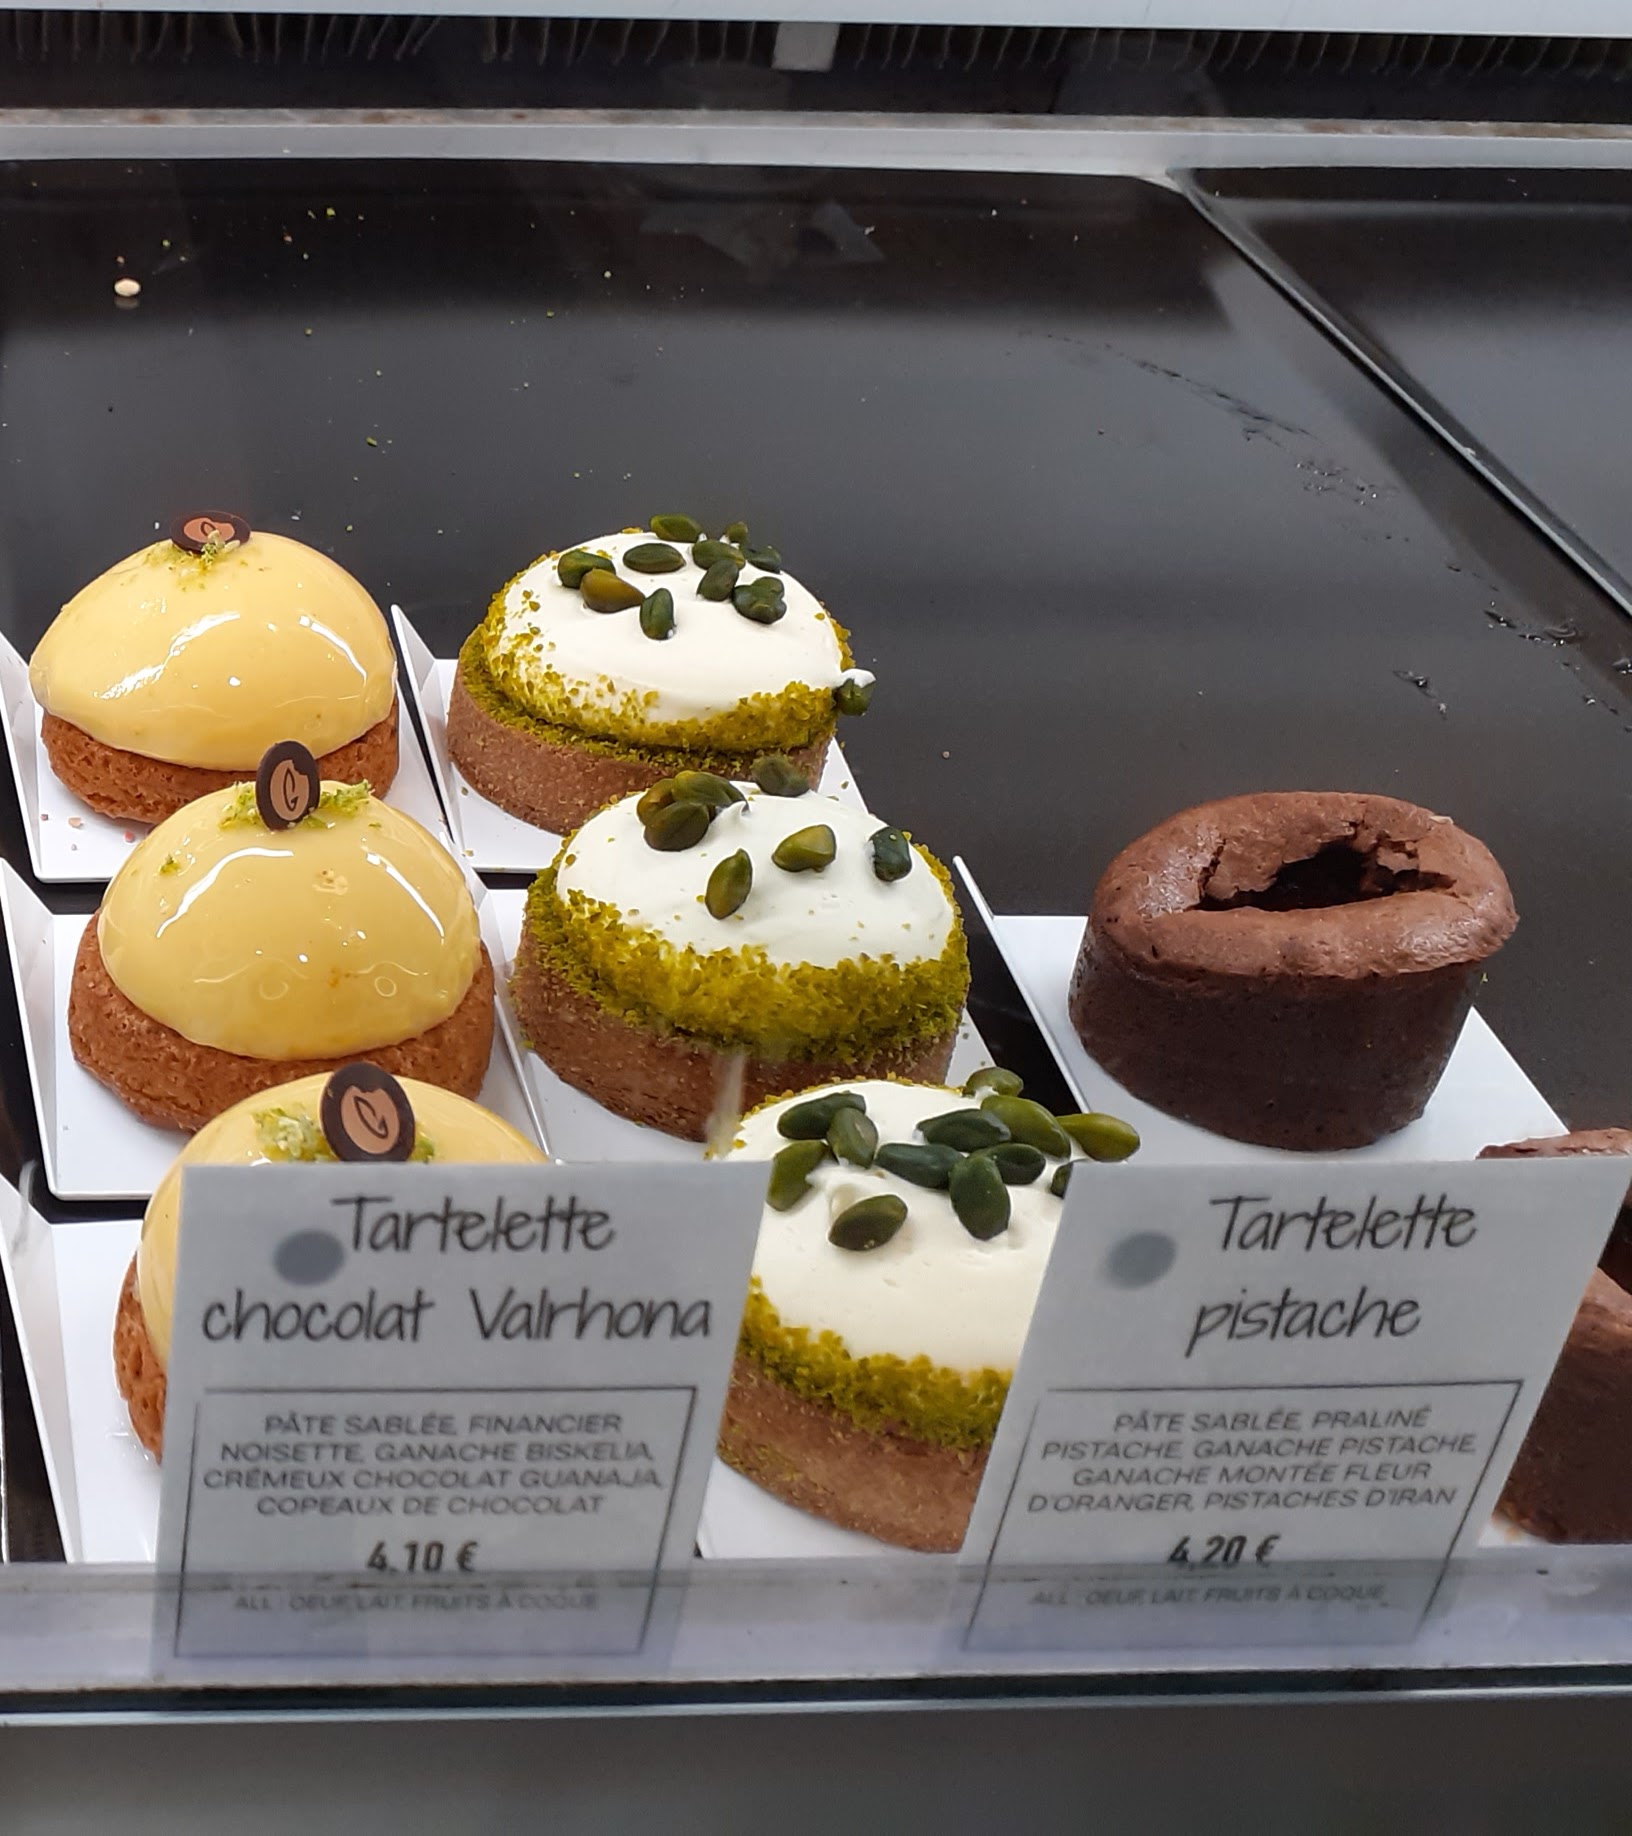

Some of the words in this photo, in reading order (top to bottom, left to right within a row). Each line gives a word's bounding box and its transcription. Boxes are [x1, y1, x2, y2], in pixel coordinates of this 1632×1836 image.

[330, 1195, 618, 1253] Tartelette
[1209, 1193, 1478, 1252] Tartelette
[202, 1289, 436, 1343] chocolat
[469, 1286, 713, 1343] Valrhona
[1184, 1285, 1422, 1359] pistache
[264, 1411, 335, 1435] PÂTE
[469, 1413, 623, 1435] FINANCIER
[1113, 1409, 1186, 1433] PÂTE
[1311, 1403, 1433, 1429] PRALINÉ
[374, 1441, 518, 1462] GANACHE
[1192, 1437, 1334, 1460] GANACHE
[203, 1466, 346, 1489] CRÉMEUX
[352, 1468, 512, 1489] CHOCOLAT
[1072, 1466, 1211, 1487] GANACHE
[1217, 1460, 1339, 1485] MONTÉE
[1343, 1462, 1433, 1483] FLEUR
[256, 1495, 393, 1516] COPEAUX
[402, 1495, 440, 1516] DE
[447, 1494, 605, 1515] CHOCOLAT
[1203, 1489, 1359, 1512] PISTACHES
[1364, 1486, 1458, 1509] D'IRAN
[455, 1540, 479, 1573] €
